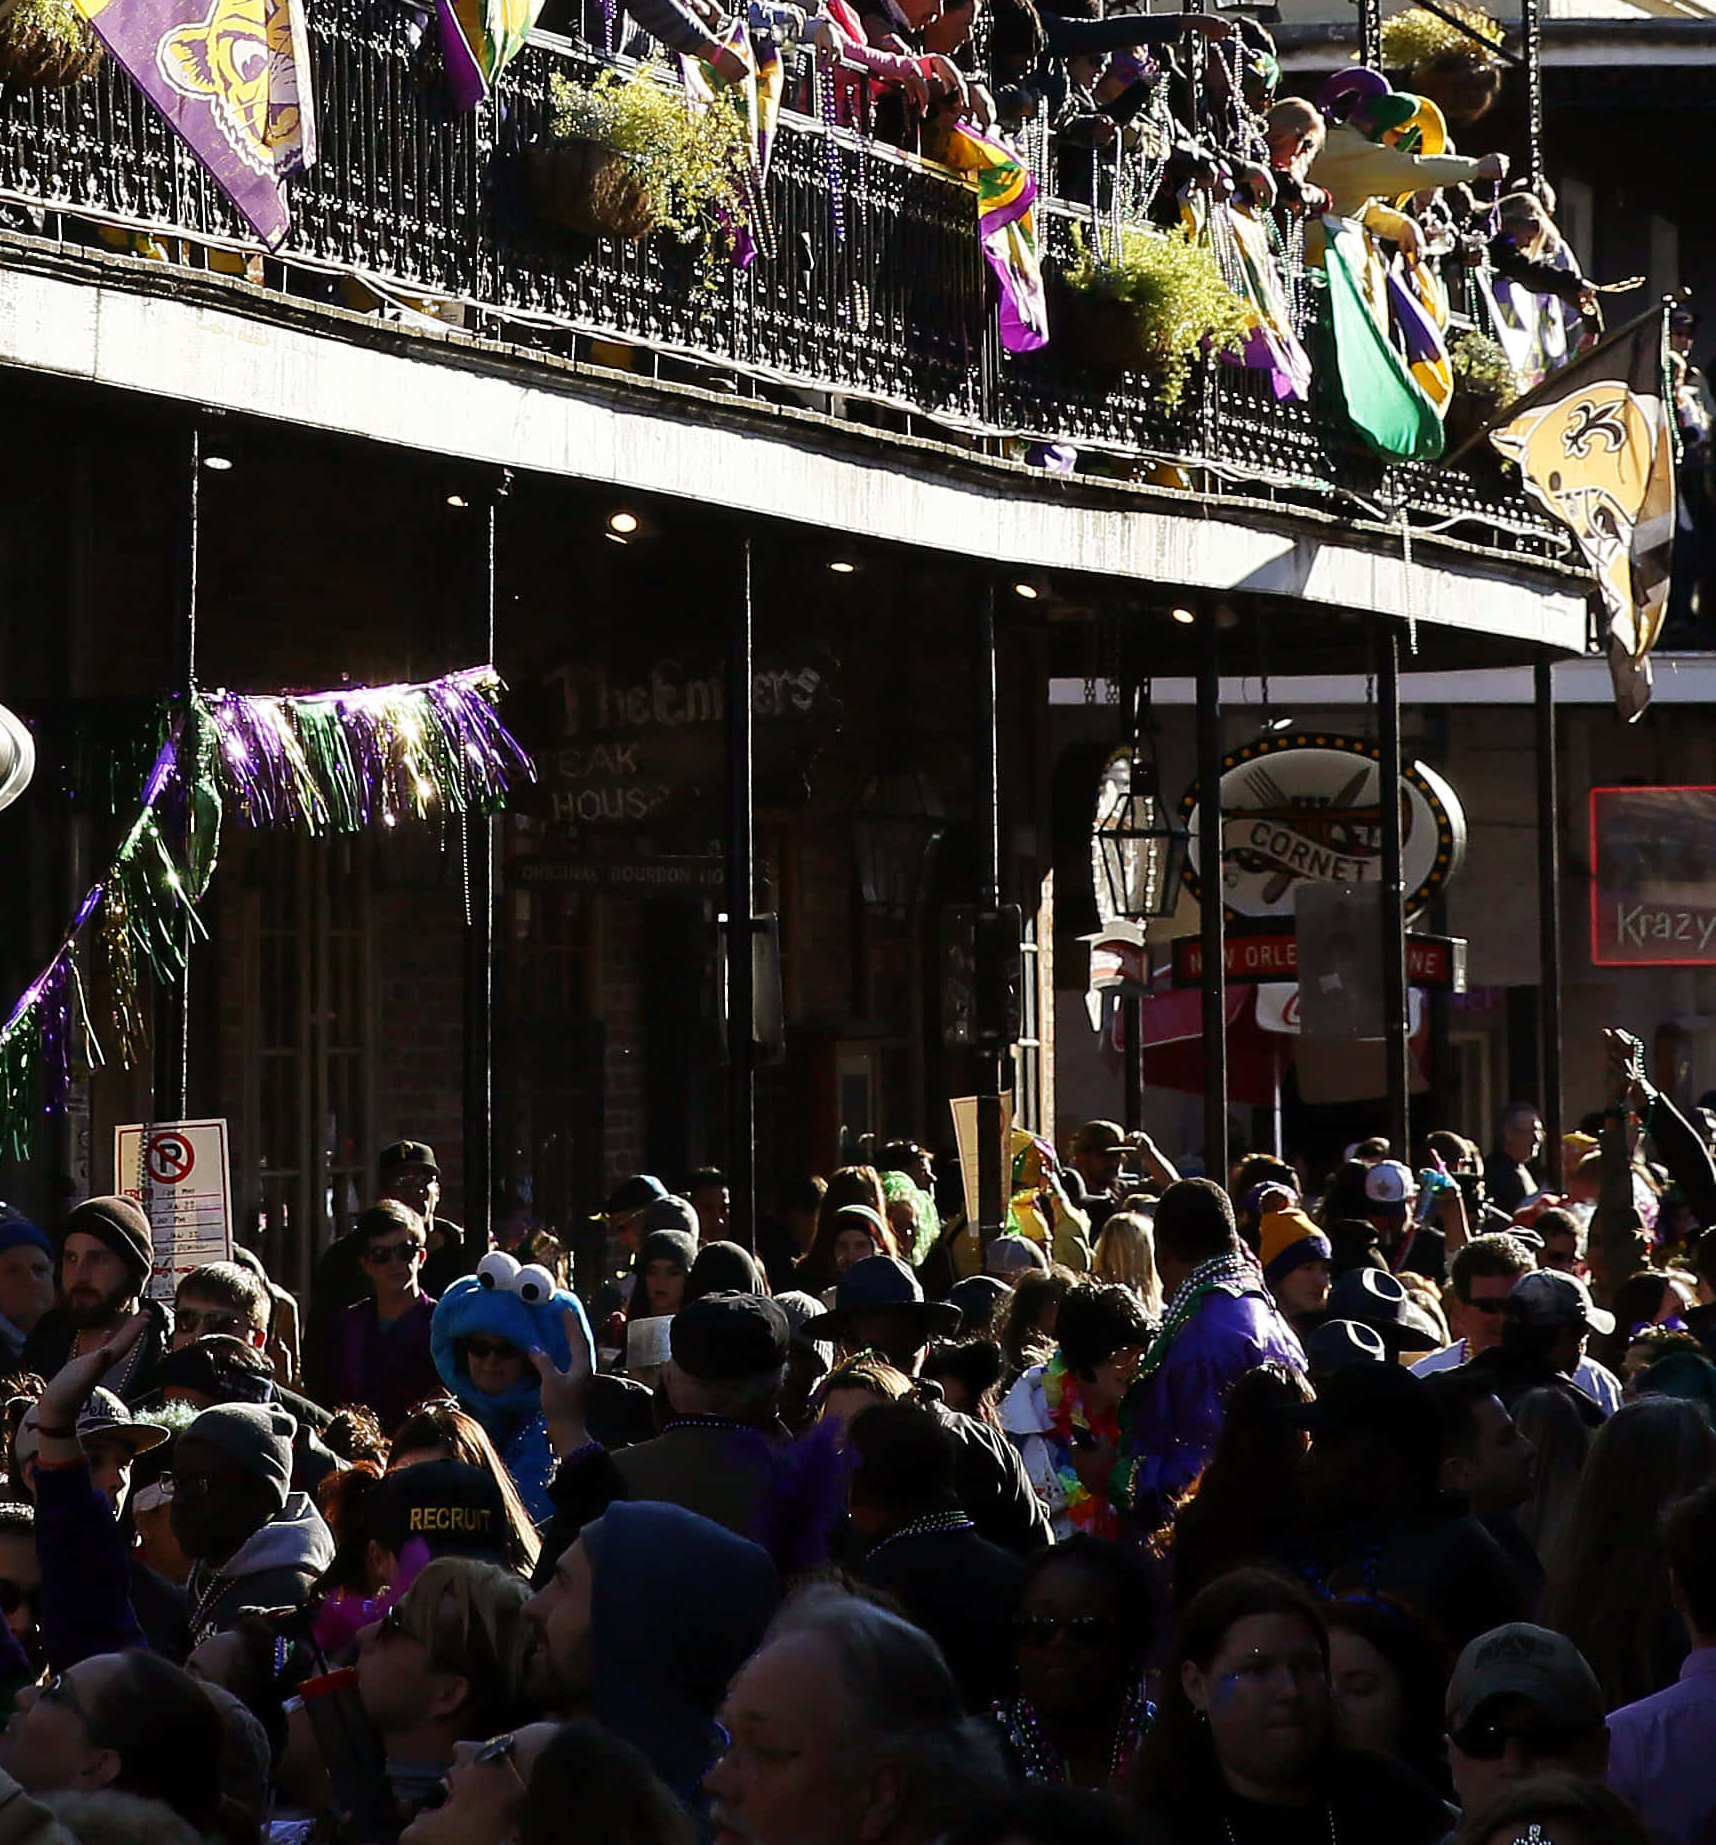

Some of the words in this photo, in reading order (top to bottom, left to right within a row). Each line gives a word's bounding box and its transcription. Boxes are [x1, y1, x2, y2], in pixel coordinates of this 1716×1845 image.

[651, 657, 821, 728] Emers
[1250, 822, 1371, 882] CORNET
[1245, 943, 1299, 967] ORLE
[409, 1506, 491, 1531] RECRUIT
